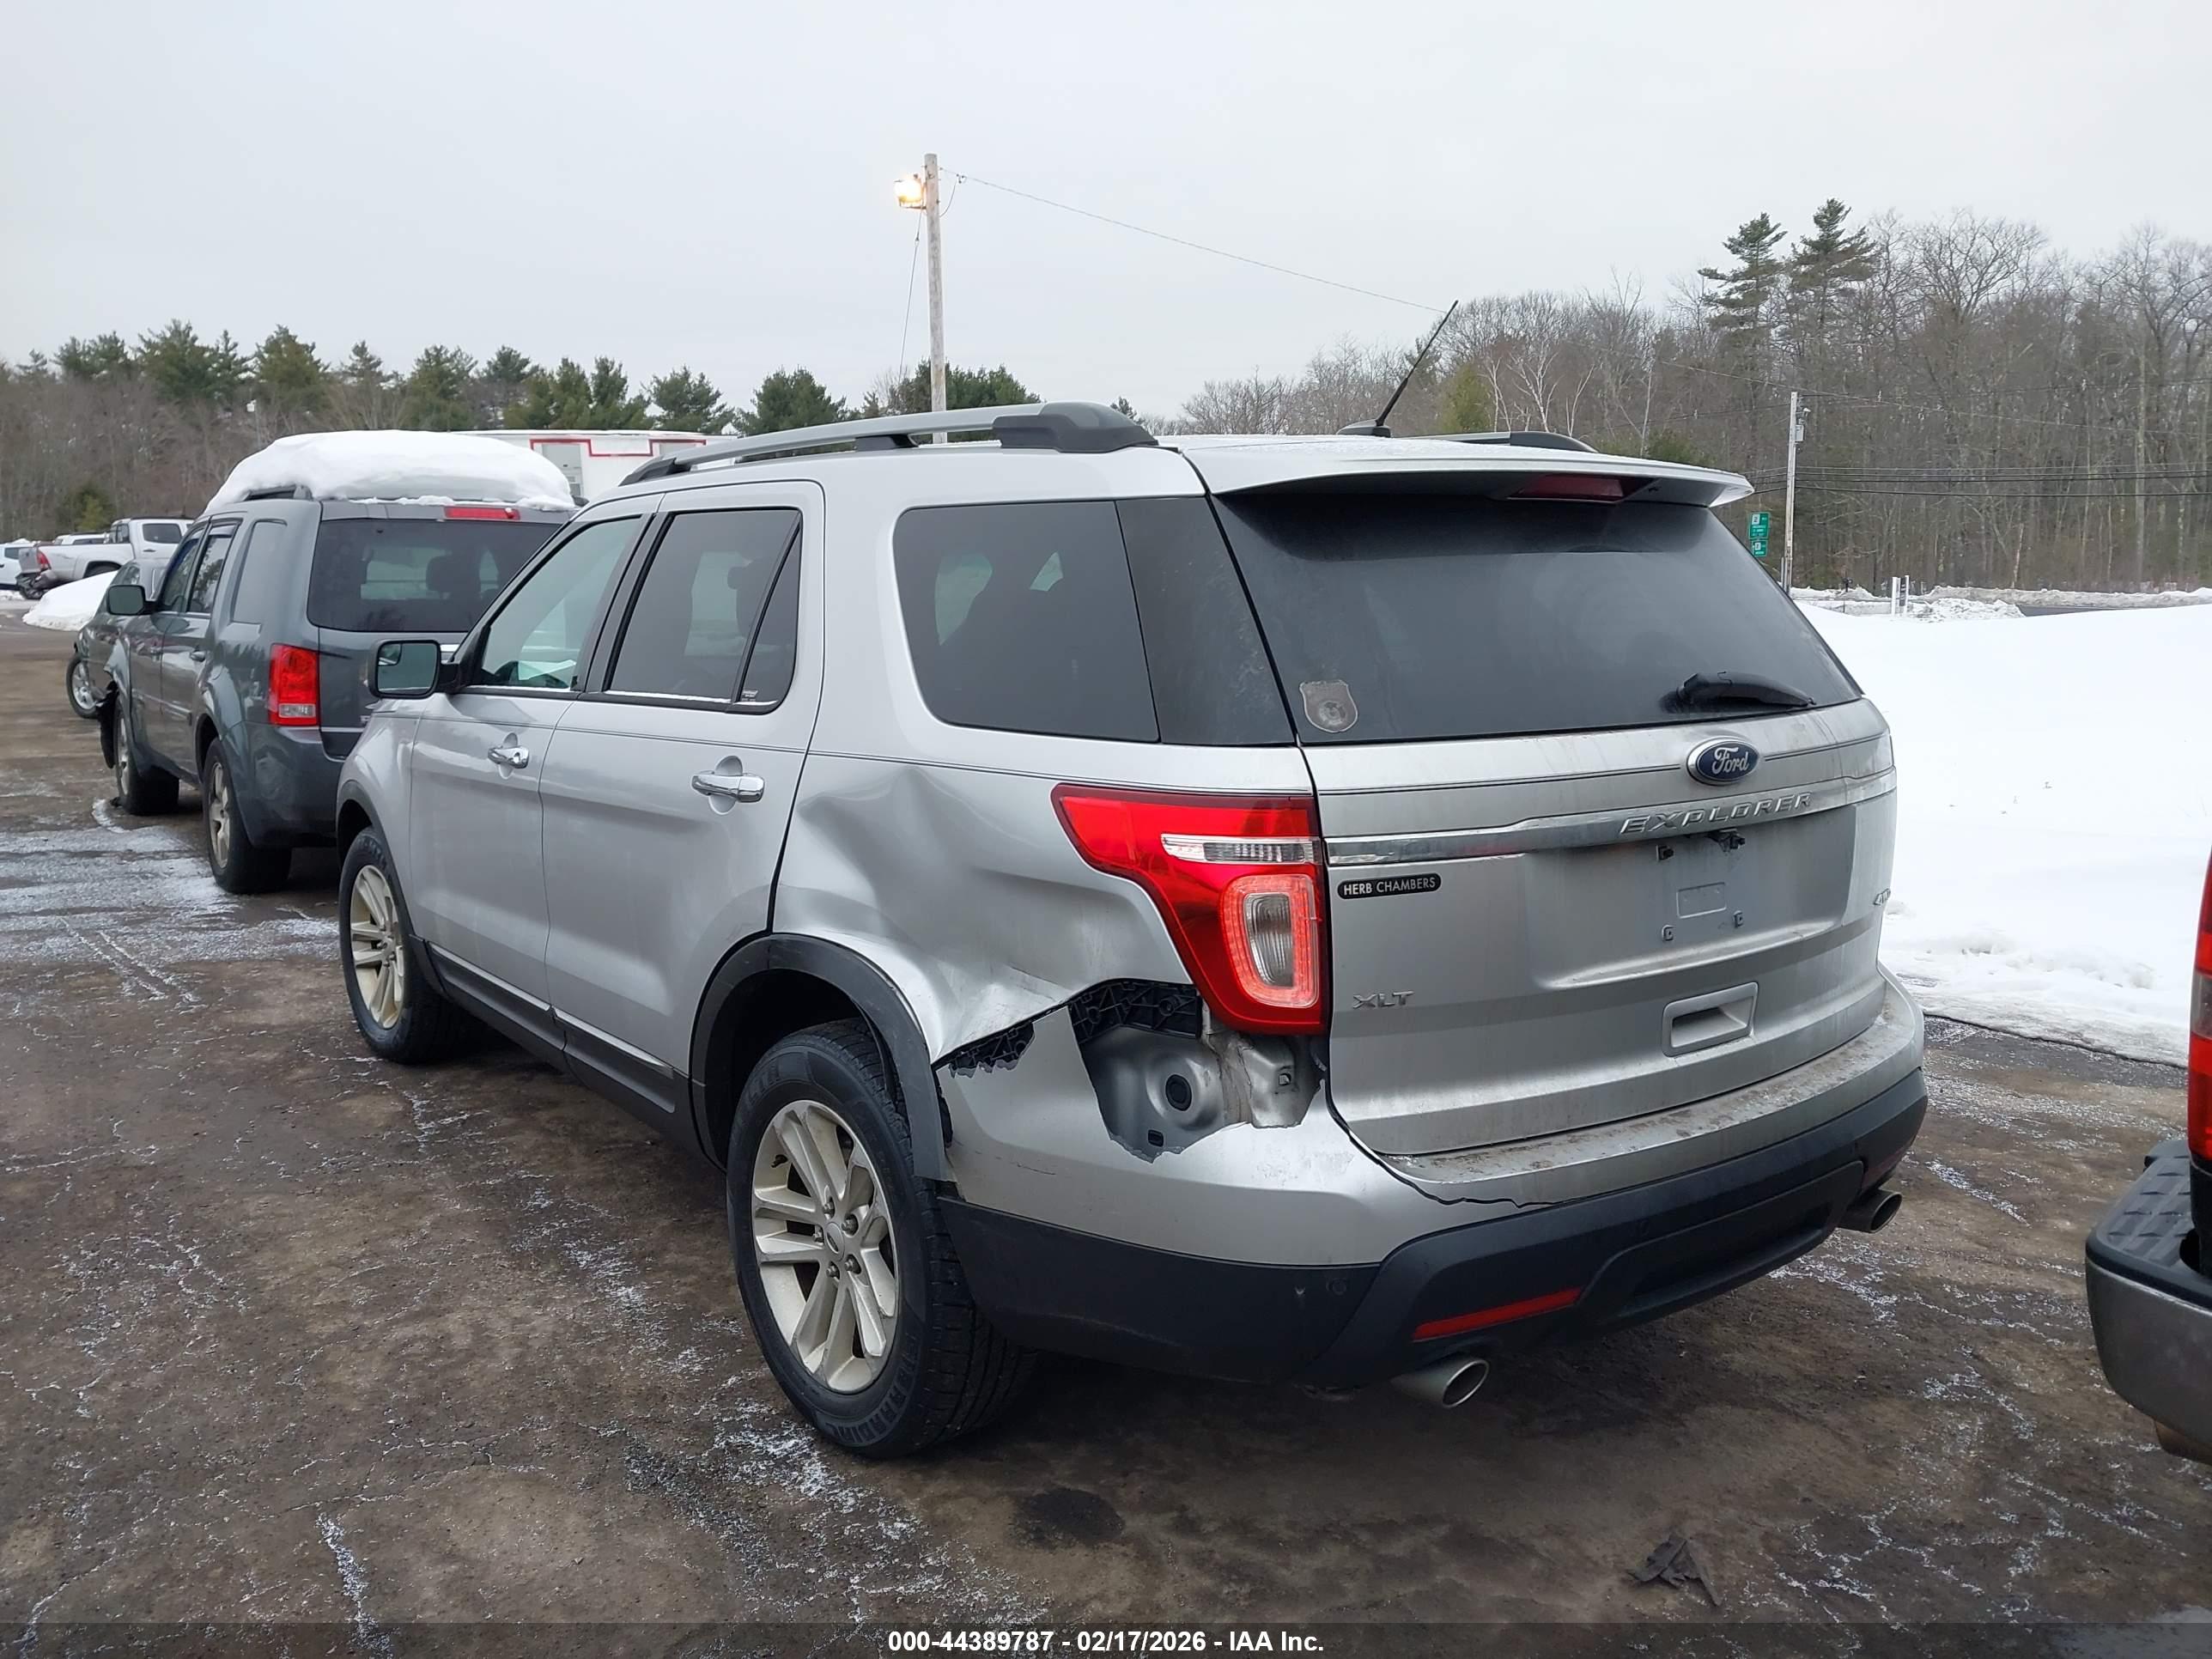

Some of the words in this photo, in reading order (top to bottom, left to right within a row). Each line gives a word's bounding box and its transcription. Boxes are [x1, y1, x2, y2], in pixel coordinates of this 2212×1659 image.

[1711, 747, 1749, 774] Ford
[1620, 791, 1813, 834] EXPLORER
[1344, 883, 1372, 896] HERB
[1376, 877, 1436, 892] CHAMBERS
[1353, 990, 1413, 1008] XLT
